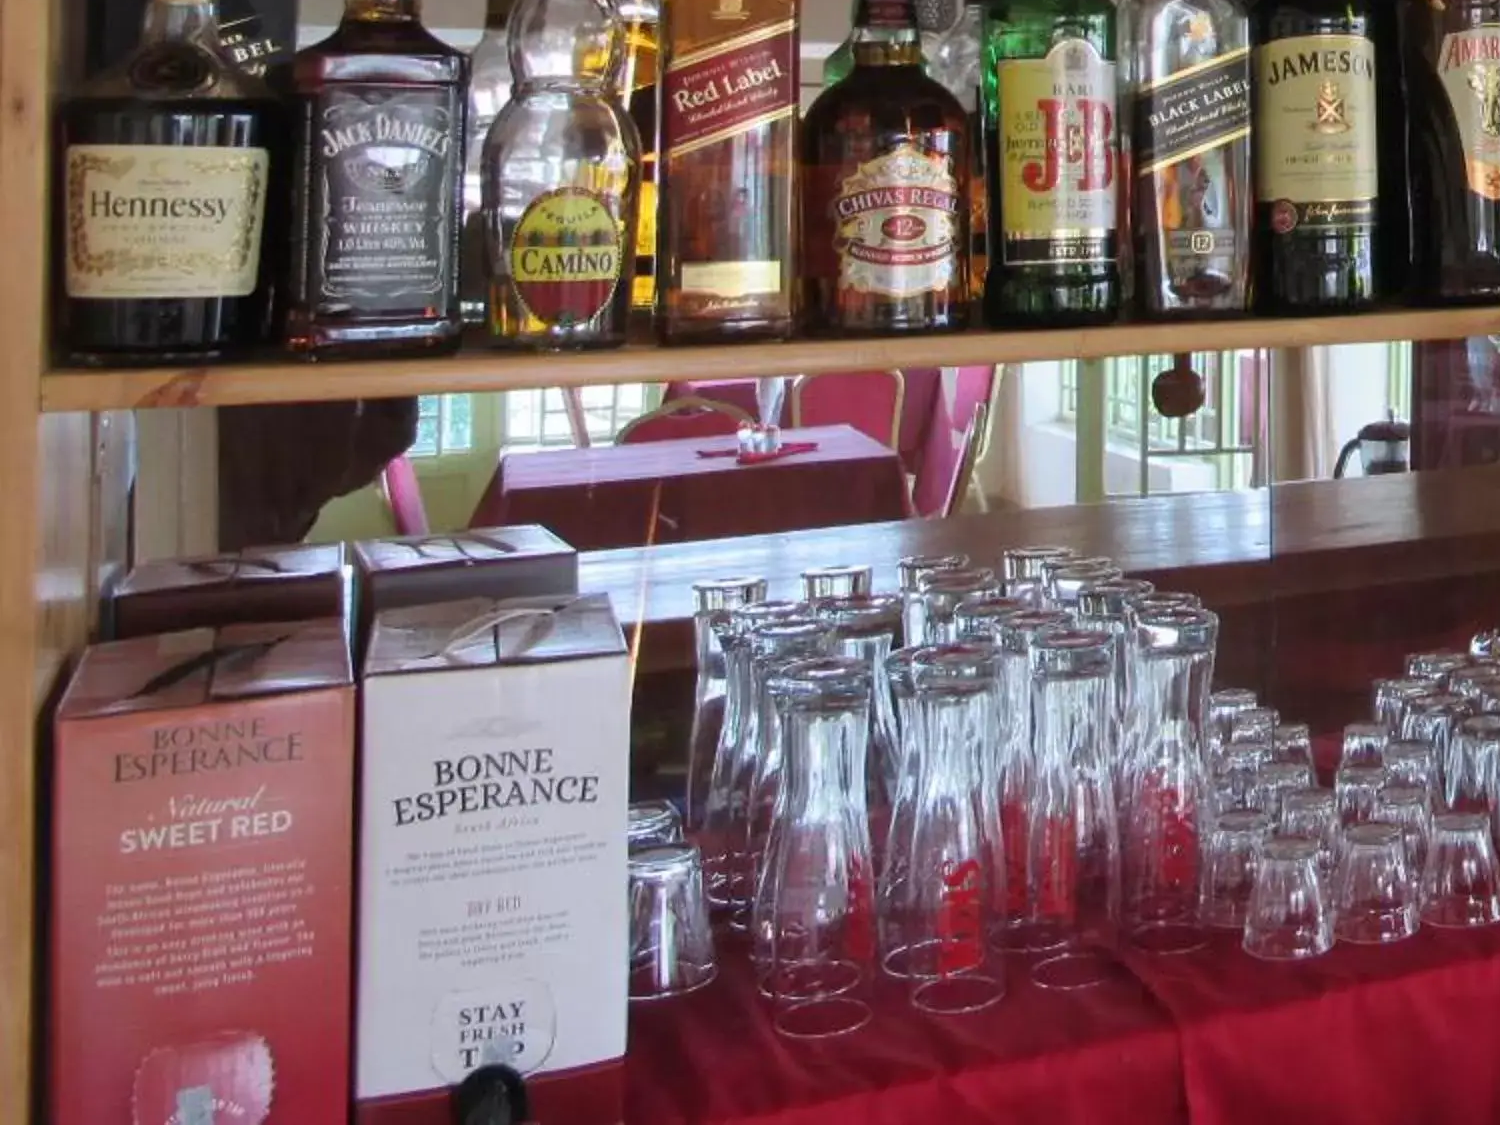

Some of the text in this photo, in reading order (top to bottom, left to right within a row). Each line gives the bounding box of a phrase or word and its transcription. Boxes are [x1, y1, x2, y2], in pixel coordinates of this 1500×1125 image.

[672, 80, 720, 113] Red
[722, 58, 783, 96] Label
[1268, 50, 1374, 86] JAMESON
[1149, 98, 1200, 127] BLACK
[1203, 79, 1251, 106] LABEL
[321, 112, 453, 159] JACK DANIEL'S
[90, 189, 233, 224] Hennessy
[838, 188, 958, 216] CHIVAS REGAL
[894, 219, 913, 236] 12
[153, 716, 266, 751] BONNE
[114, 730, 305, 784] ESPERANCE
[433, 748, 554, 787] BONNE
[168, 783, 268, 820] Natural
[392, 775, 600, 827] ESPERANCE
[120, 810, 293, 854] SWEET RED
[459, 1000, 526, 1026] STAY
[459, 1040, 525, 1069] TP
